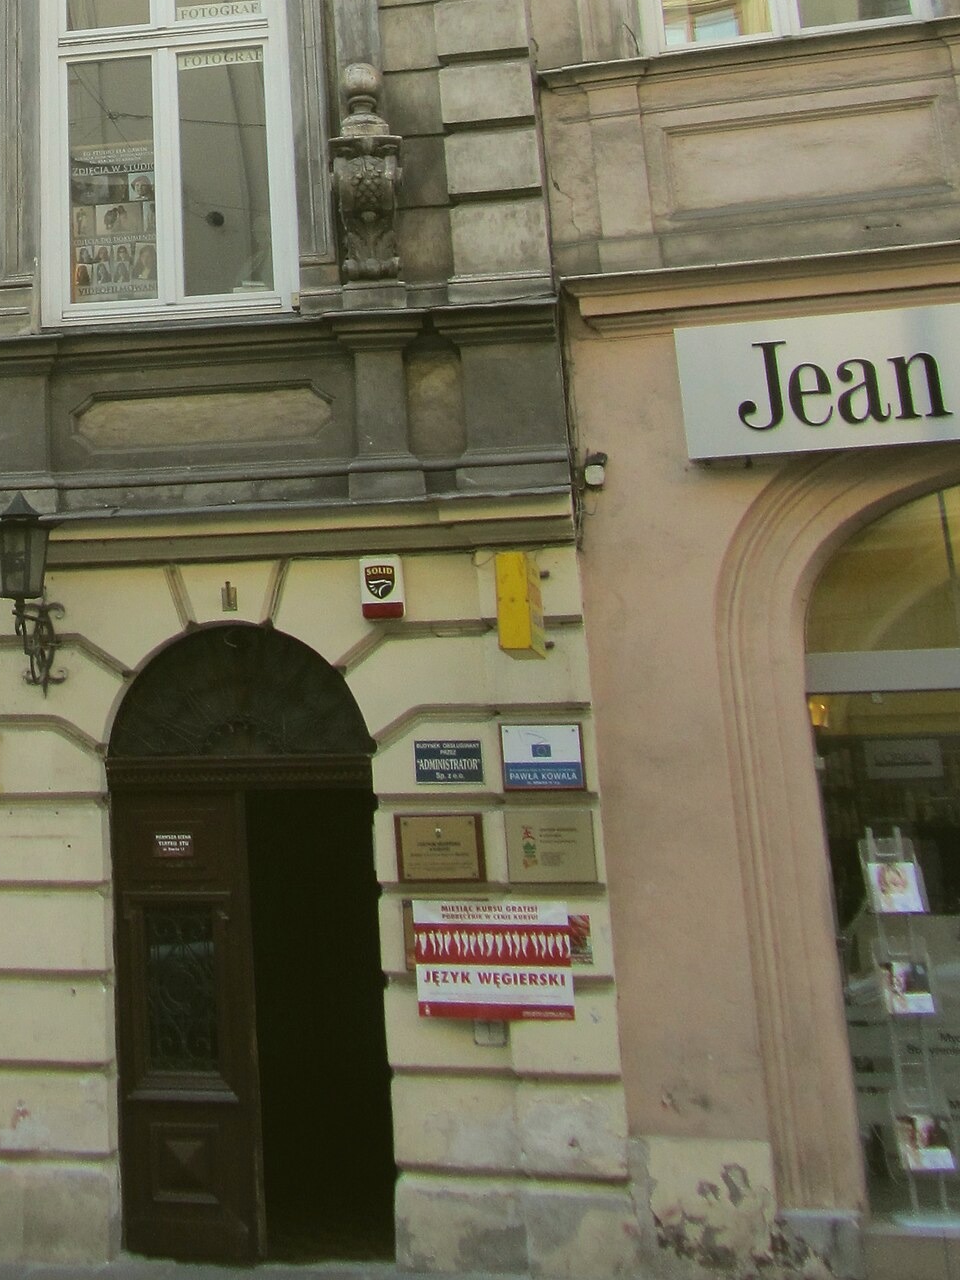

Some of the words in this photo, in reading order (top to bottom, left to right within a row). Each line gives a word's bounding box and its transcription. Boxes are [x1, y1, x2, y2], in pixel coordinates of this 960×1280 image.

[180, 2, 259, 20] FOTOGRAF
[183, 49, 263, 67] FOTOGRAF
[111, 165, 121, 173] W
[737, 339, 953, 431] Jean
[366, 566, 393, 576] SOLID
[509, 772, 539, 781] PAWŁA
[541, 772, 578, 781] KOWALA
[441, 904, 473, 914] MIESIĄC
[476, 905, 503, 913] KURSU
[423, 970, 472, 987] JĘZYK
[477, 972, 567, 988] WĘGIERSKI
